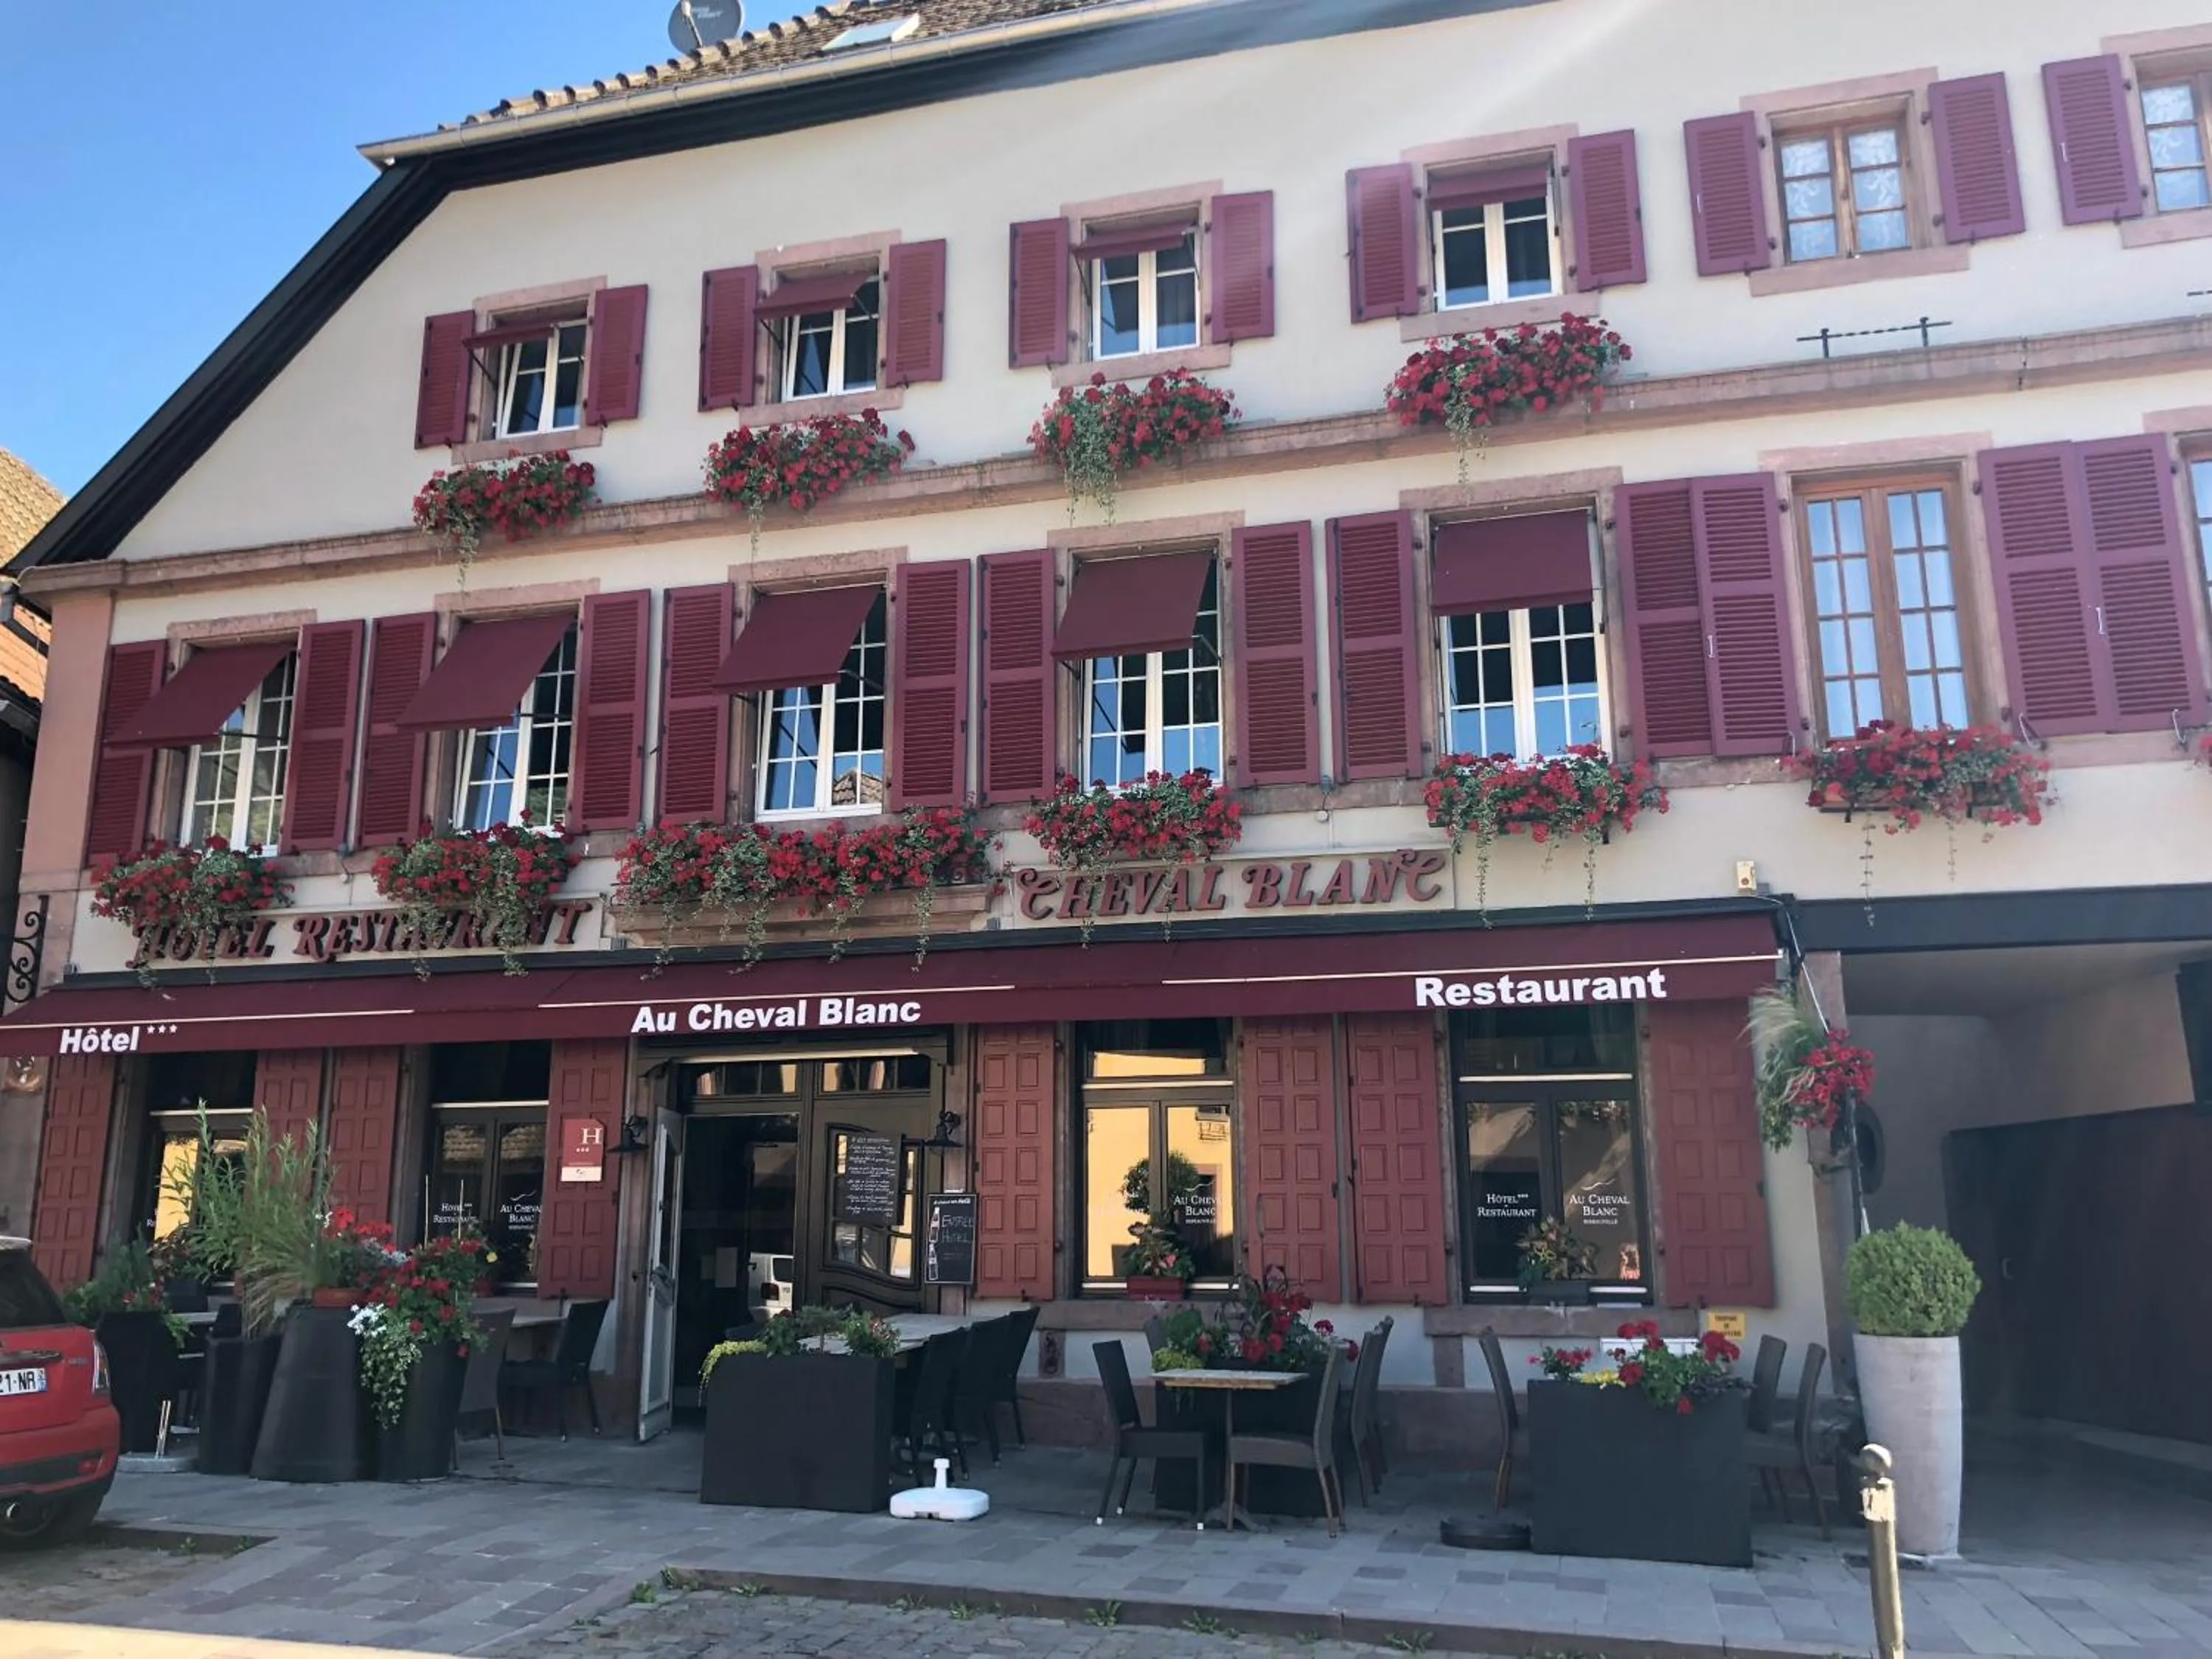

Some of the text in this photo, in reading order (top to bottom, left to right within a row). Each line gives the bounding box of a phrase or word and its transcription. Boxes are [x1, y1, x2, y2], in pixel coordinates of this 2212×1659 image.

[1015, 849, 1445, 920] CHEVAL BLANC
[1415, 967, 1667, 1007] Restaurant
[631, 998, 921, 1032] Au Cheval Blanc
[59, 1026, 140, 1054] Hôtel
[581, 1127, 603, 1145] H
[1191, 1196, 1225, 1206] CHEV
[1569, 1194, 1630, 1205] AU CHEVAL
[1185, 1206, 1216, 1217] BLANC
[1477, 1206, 1537, 1218] RESTAURANT
[1583, 1206, 1618, 1217] BLANC
